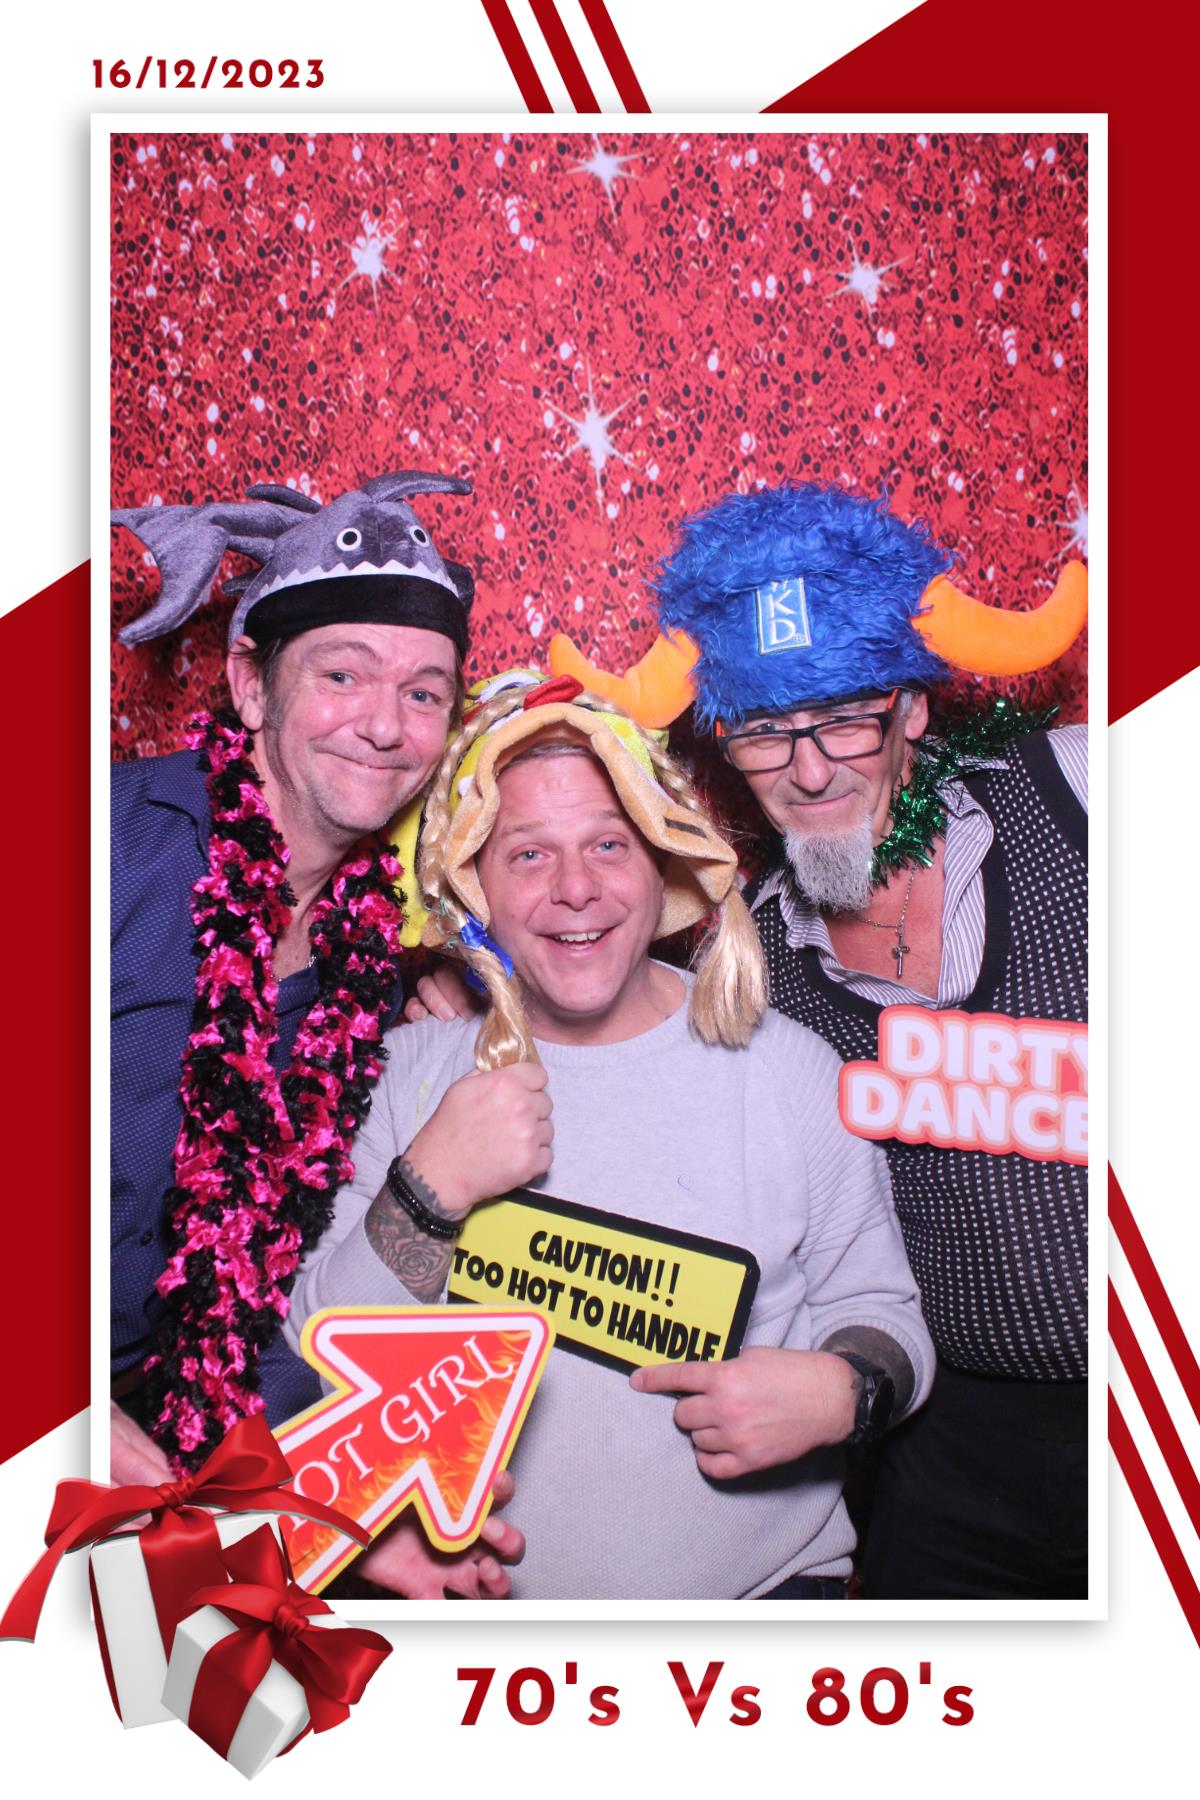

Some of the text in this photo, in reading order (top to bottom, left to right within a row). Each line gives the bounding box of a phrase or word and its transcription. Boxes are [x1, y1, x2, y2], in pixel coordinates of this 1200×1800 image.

[452, 1248, 721, 1362] TOO HOT TO HANDLE
[528, 1230, 681, 1308] CAUTION!!
[289, 1335, 515, 1533] OT GIRL
